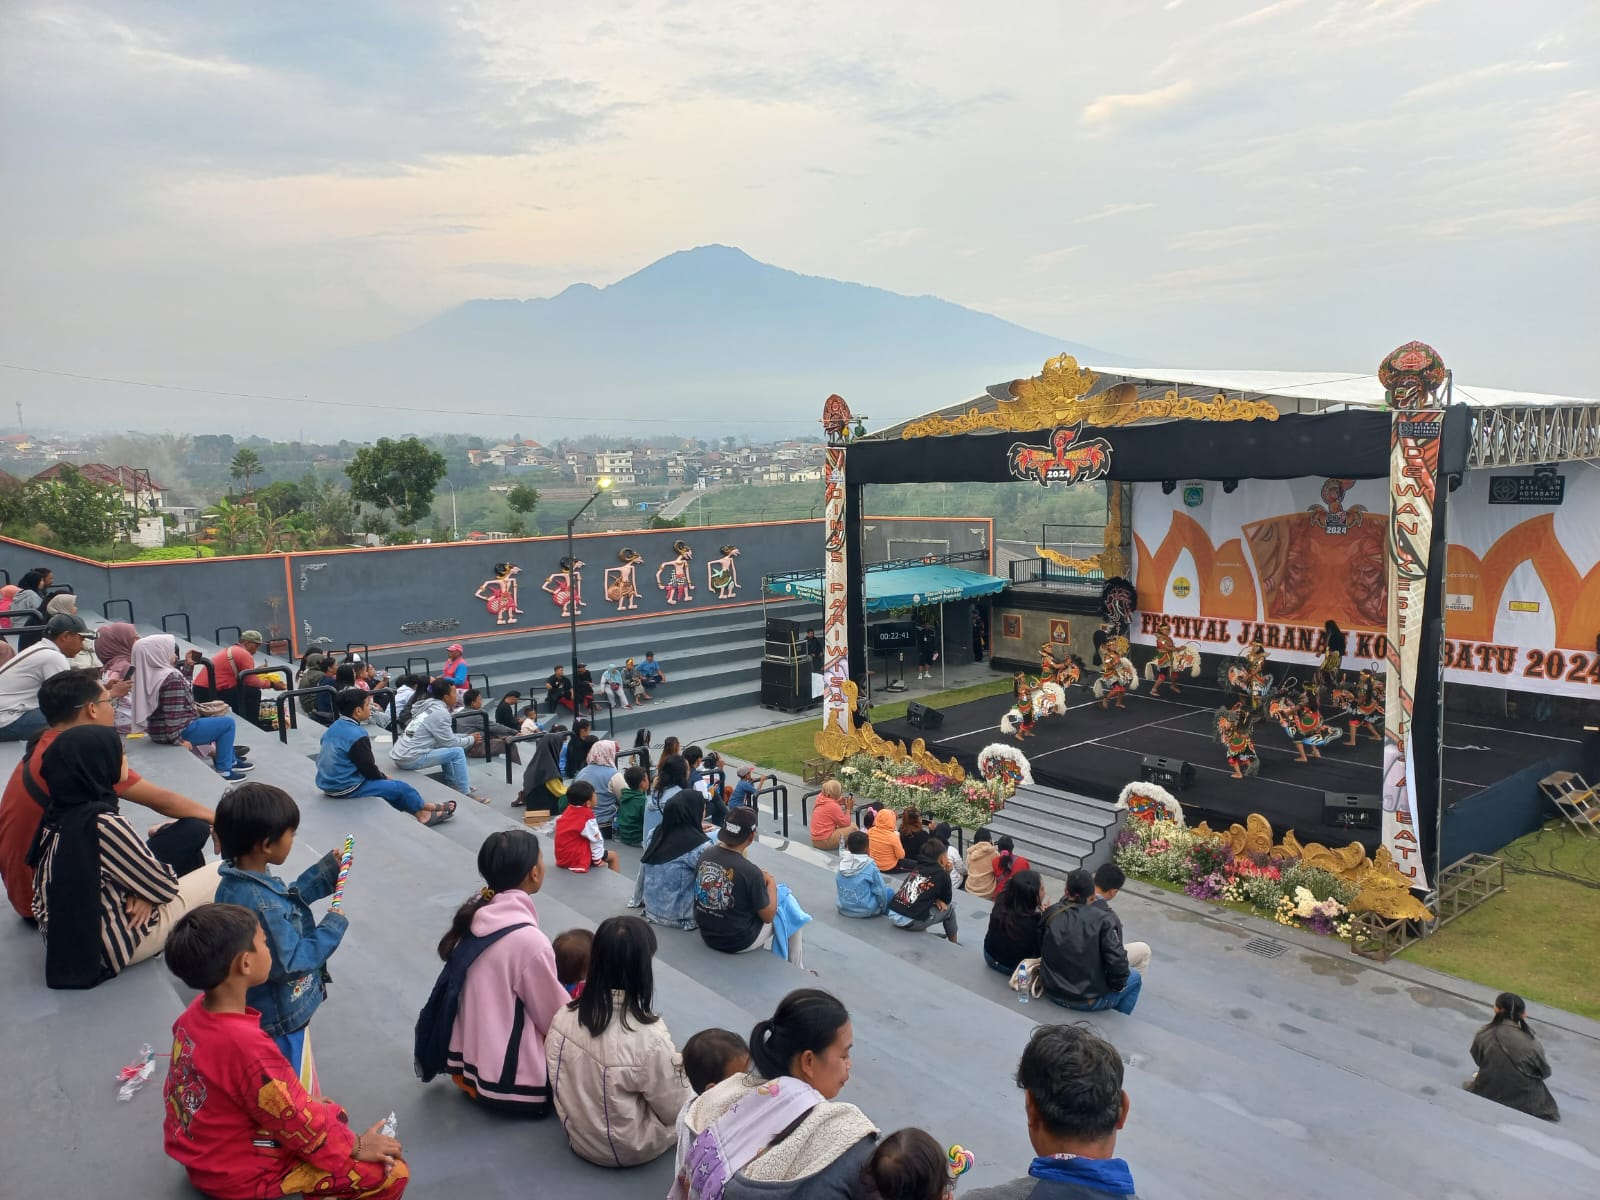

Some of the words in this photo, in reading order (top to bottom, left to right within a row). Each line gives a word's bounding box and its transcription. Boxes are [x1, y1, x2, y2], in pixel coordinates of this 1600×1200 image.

[1047, 470, 1071, 478] 2024
[1395, 446, 1425, 535] DEWAN
[830, 488, 844, 562] DINAS
[1326, 526, 1347, 534] 2024
[880, 631, 910, 640] 00:22:41
[1237, 621, 1349, 657] JARANA
[1354, 632, 1388, 659] KO
